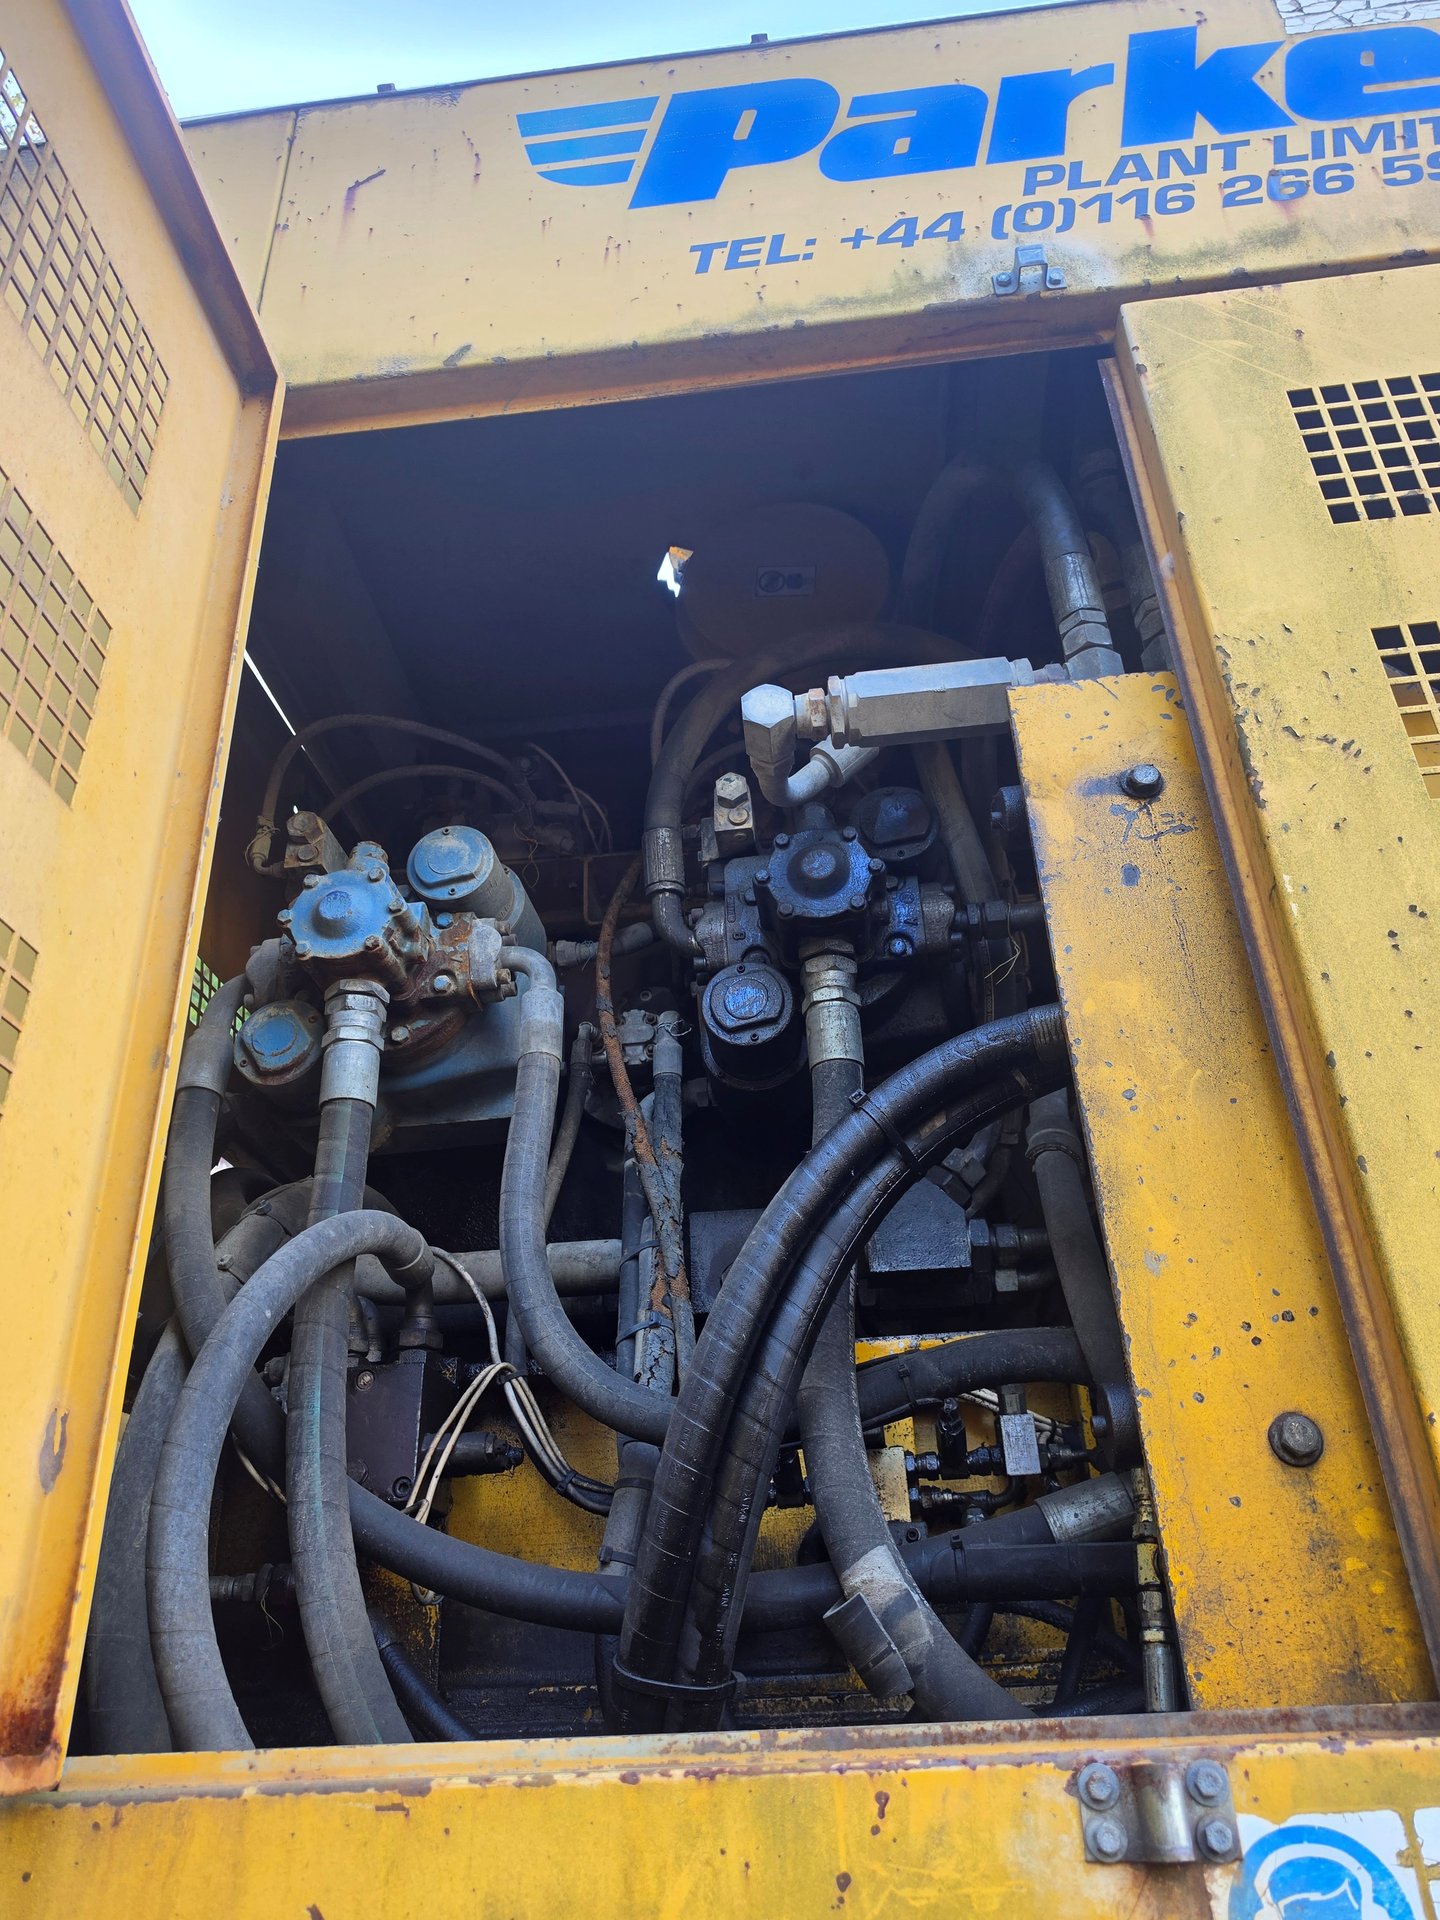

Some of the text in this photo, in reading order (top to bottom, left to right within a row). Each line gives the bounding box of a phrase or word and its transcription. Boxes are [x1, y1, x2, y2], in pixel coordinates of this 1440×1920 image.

[1023, 139, 1250, 196] PLANT
[690, 234, 814, 274] TEL:
[840, 210, 966, 250] +44
[991, 183, 1196, 241] (0)116
[1222, 163, 1356, 208] 266
